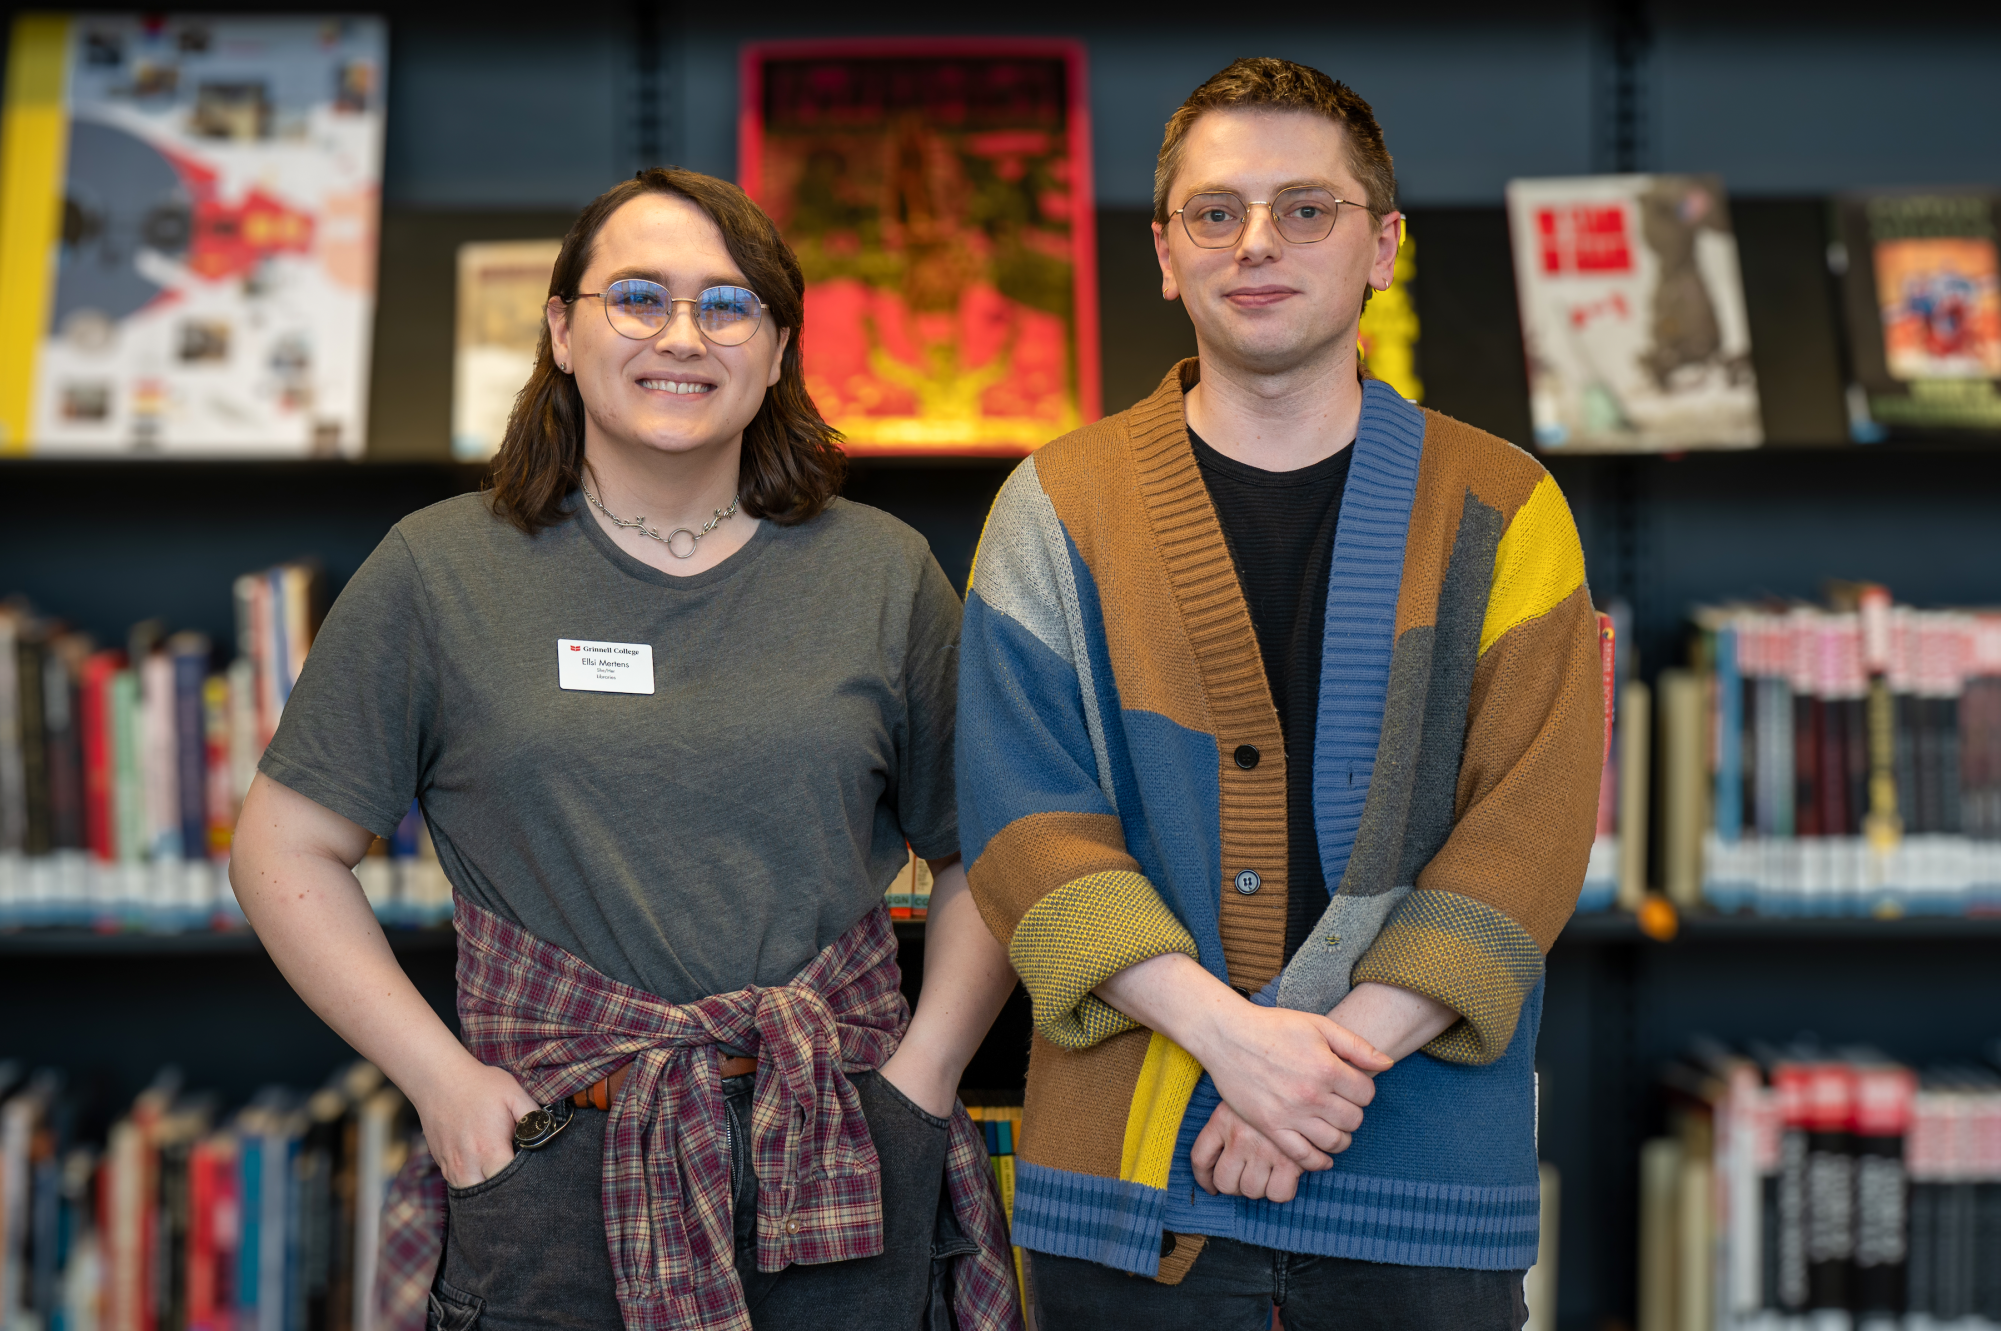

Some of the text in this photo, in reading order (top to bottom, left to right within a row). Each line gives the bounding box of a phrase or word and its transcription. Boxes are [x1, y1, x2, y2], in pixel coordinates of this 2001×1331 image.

[614, 648, 639, 656] College
[582, 658, 630, 668] Ellsi Mertens
